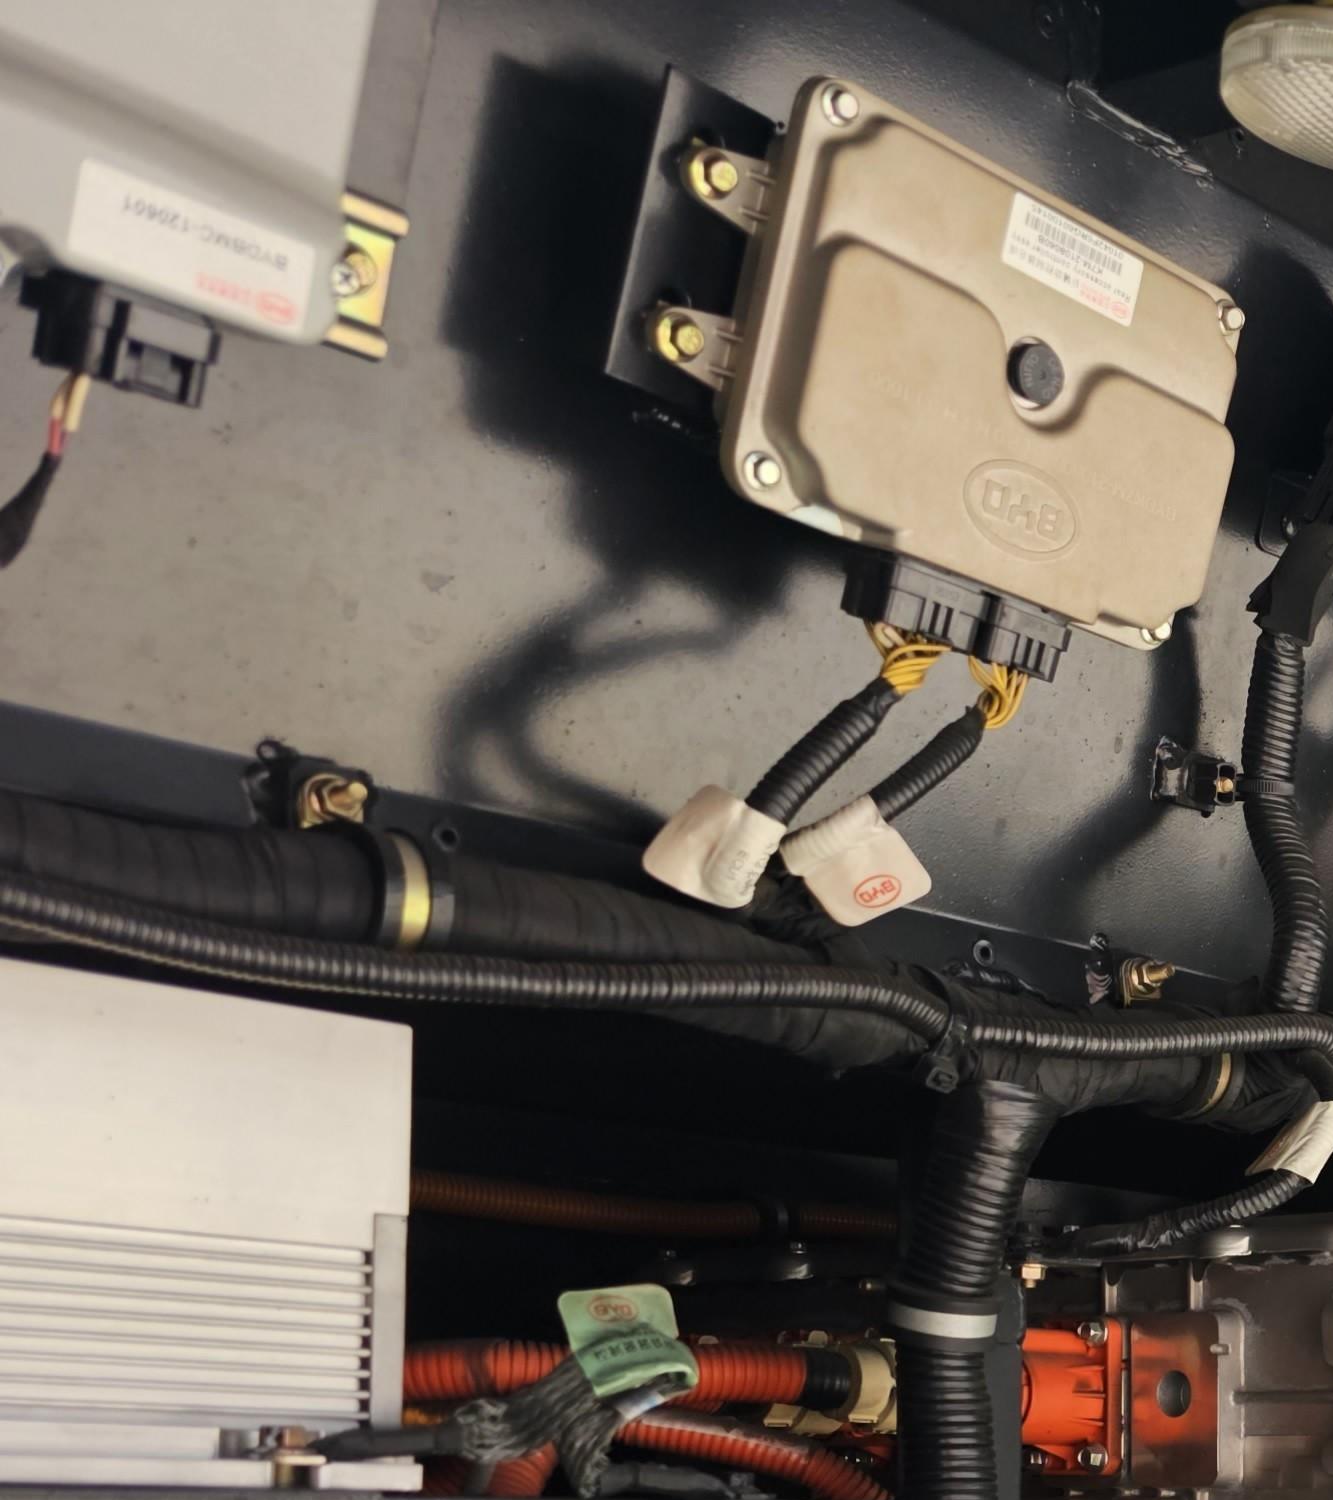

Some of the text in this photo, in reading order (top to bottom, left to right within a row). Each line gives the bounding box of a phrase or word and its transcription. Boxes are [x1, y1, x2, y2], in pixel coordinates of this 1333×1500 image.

[980, 482, 1063, 540] BYD
[858, 879, 896, 902] BYD
[594, 1303, 633, 1317] BYD
